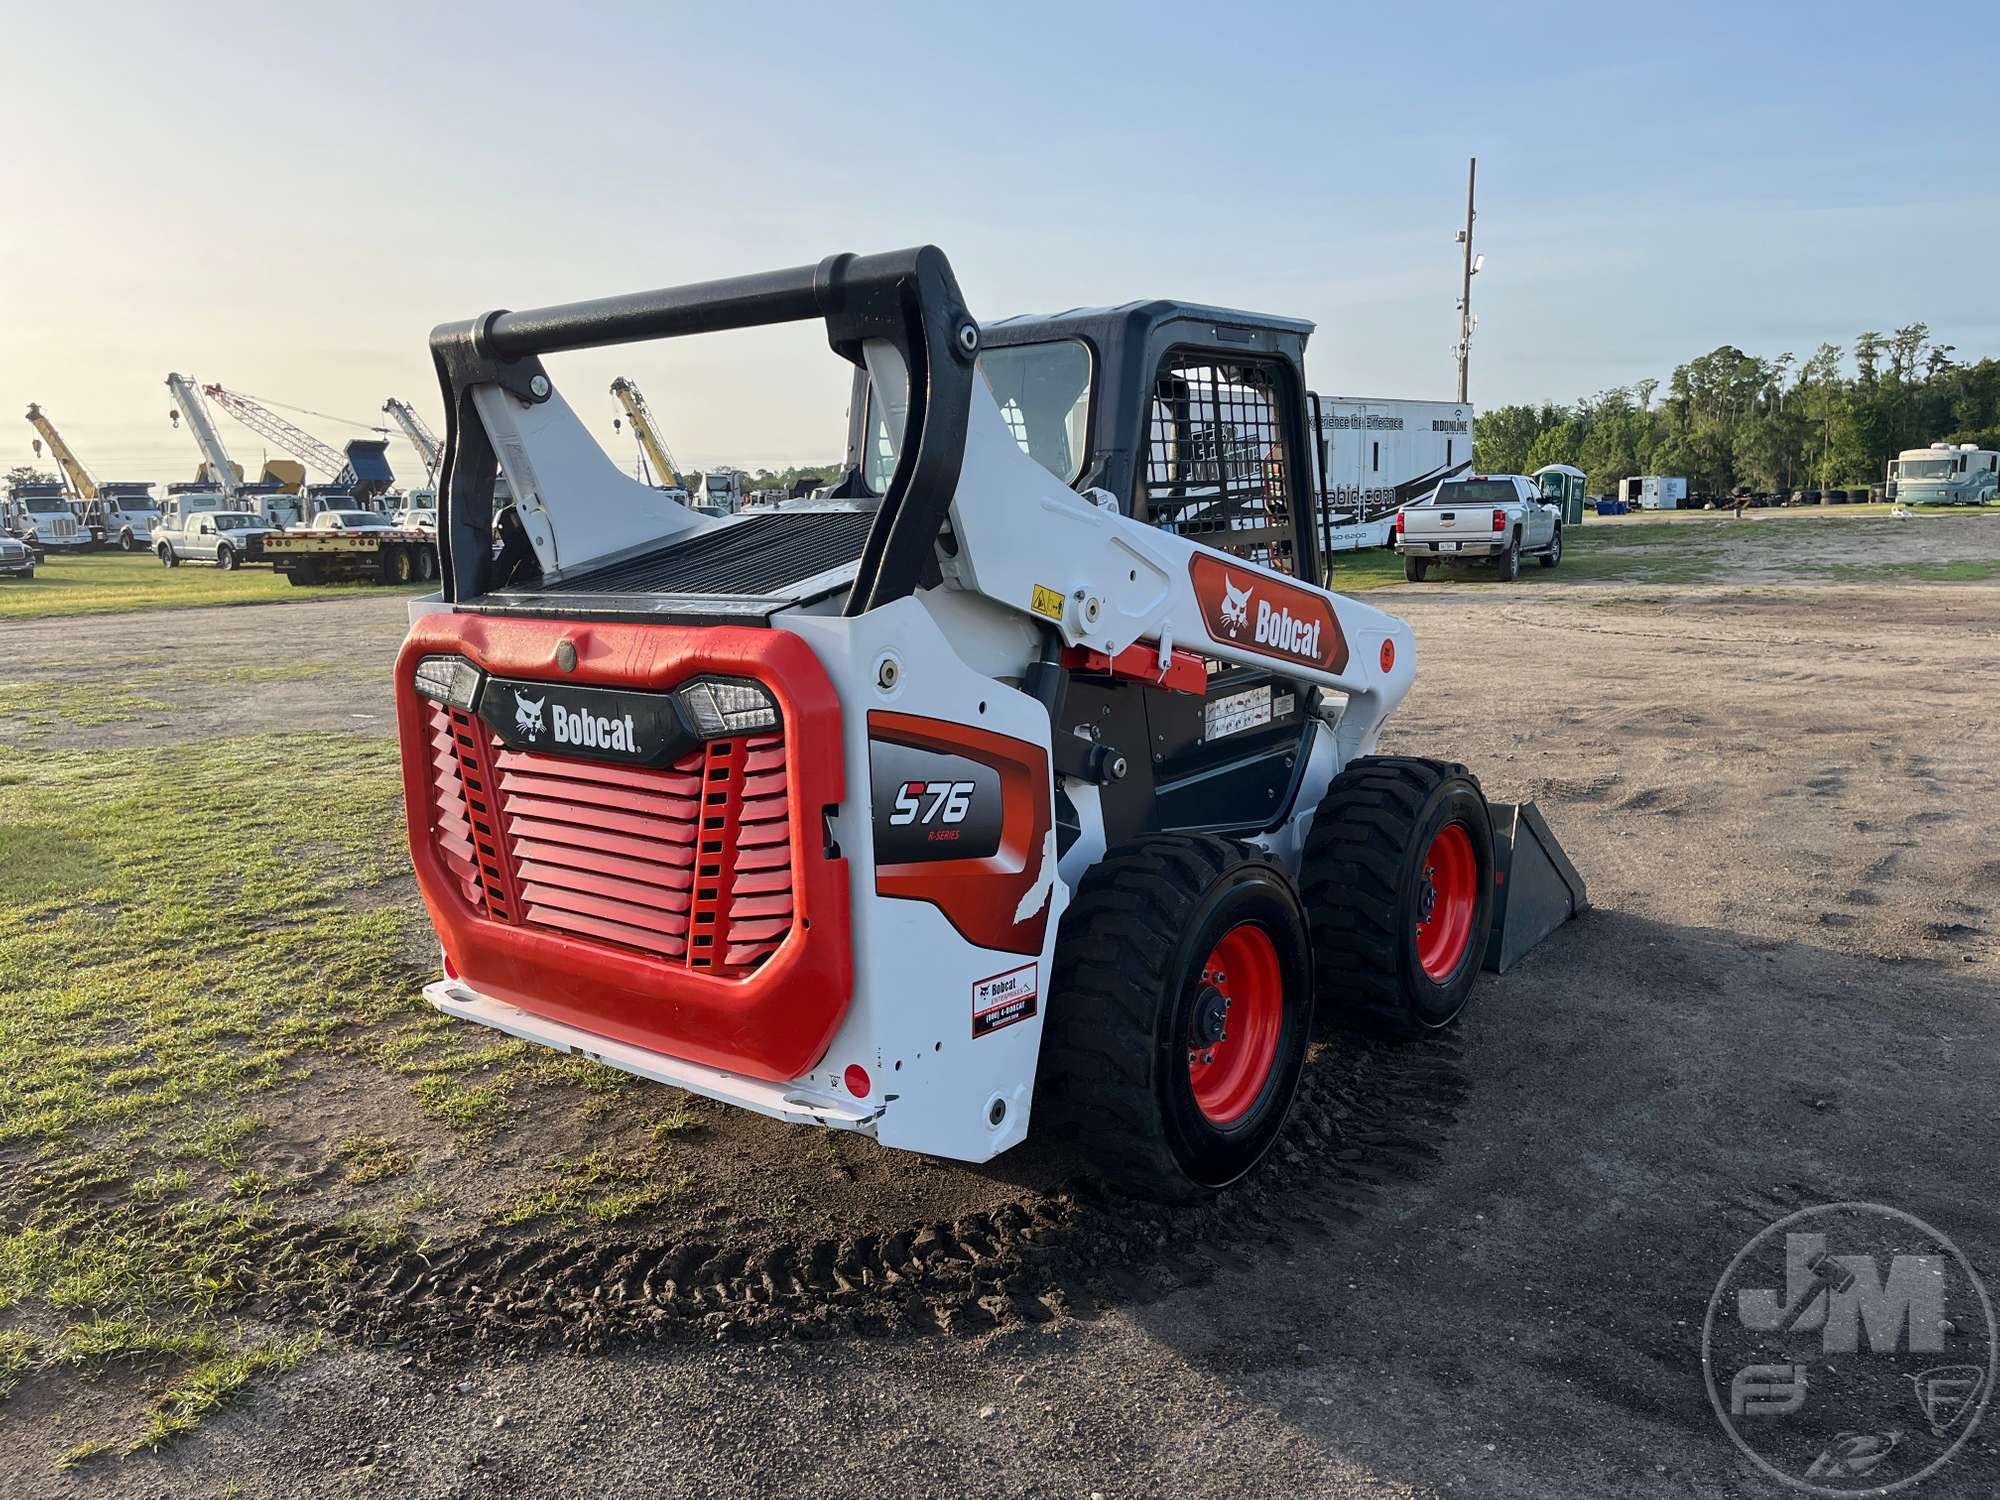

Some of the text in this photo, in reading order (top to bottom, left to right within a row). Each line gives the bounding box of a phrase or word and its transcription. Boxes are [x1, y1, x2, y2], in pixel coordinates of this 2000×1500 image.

[1254, 599, 1321, 659] Bobcat
[552, 704, 636, 753] Bobcat
[889, 781, 976, 825] S76
[928, 830, 961, 841] R-SERIES
[992, 978, 1016, 996] Bobcat
